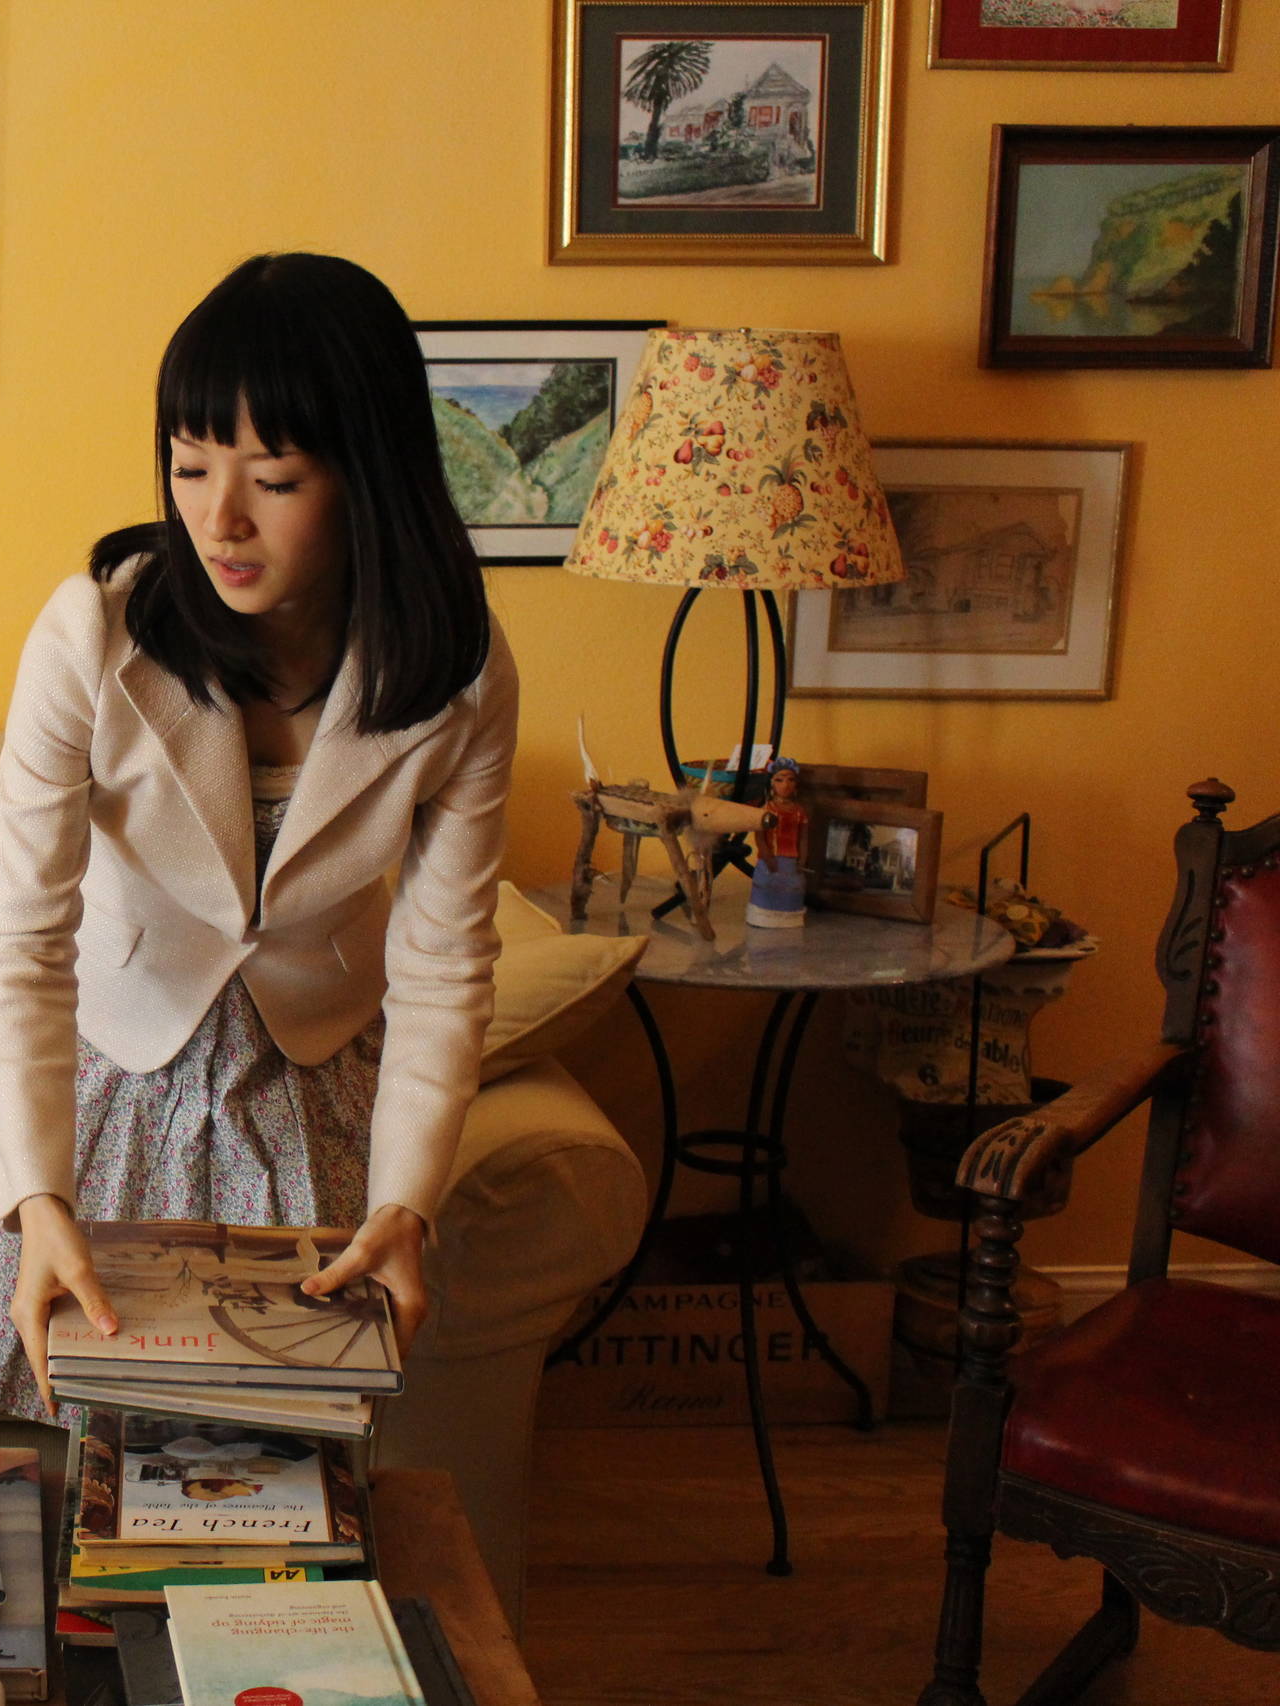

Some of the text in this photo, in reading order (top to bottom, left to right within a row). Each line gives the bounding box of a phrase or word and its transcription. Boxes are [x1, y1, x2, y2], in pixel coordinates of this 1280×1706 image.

[592, 1292, 787, 1312] AMPAGNE
[54, 1330, 220, 1353] junk style
[558, 1330, 829, 1366] AITTINGER
[141, 1503, 173, 1511] Table
[181, 1503, 200, 1511] the
[222, 1503, 277, 1512] Pleasures
[284, 1504, 305, 1512] The
[130, 1518, 313, 1533] French Tea
[269, 1569, 301, 1581] AA
[210, 1616, 352, 1628] magic of tidying up
[230, 1626, 328, 1635] life-changing
